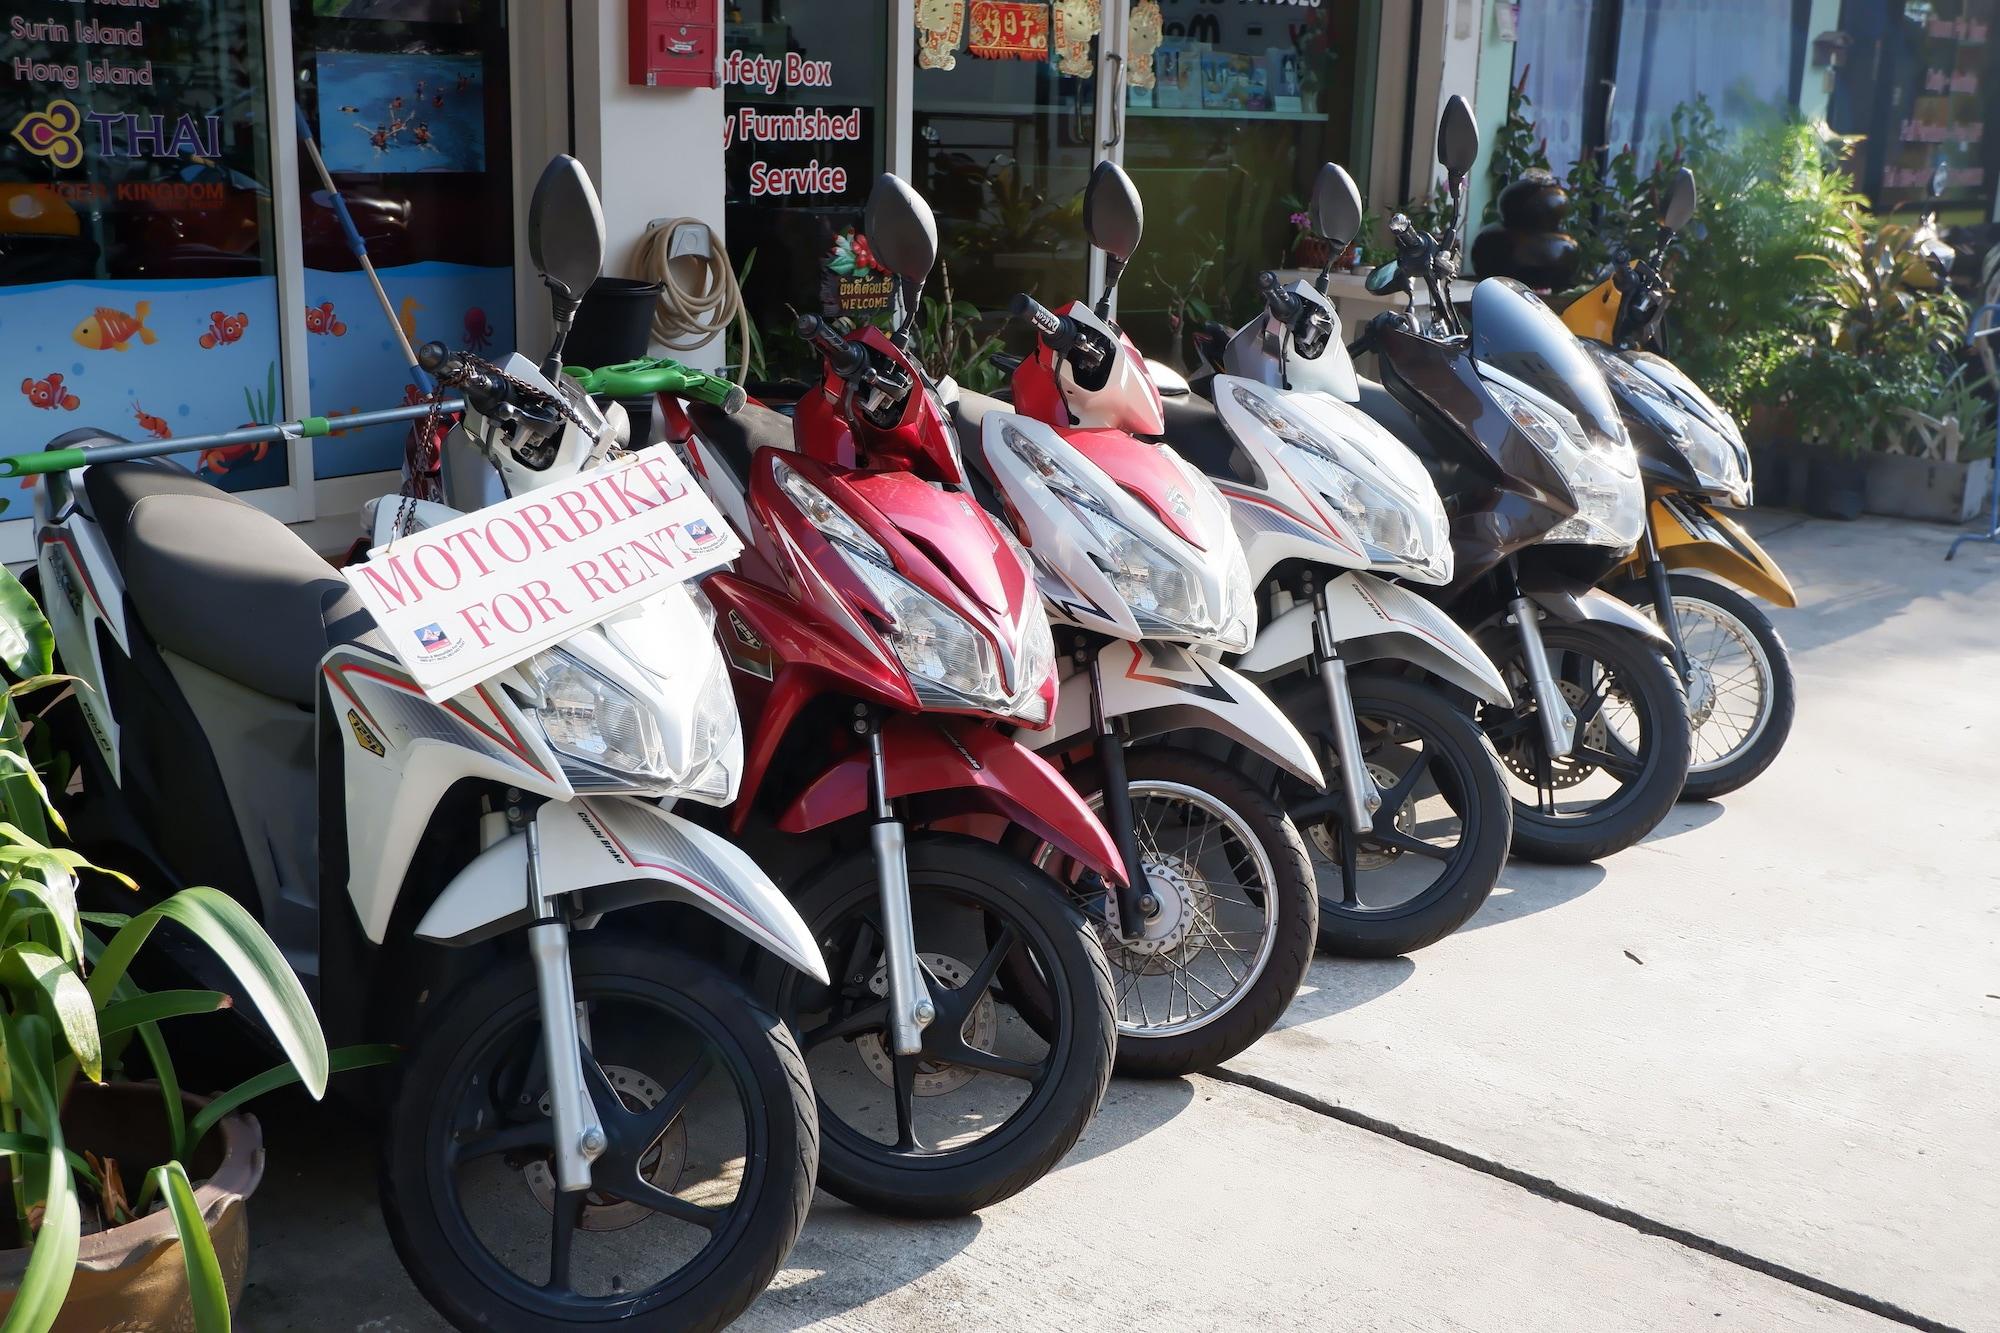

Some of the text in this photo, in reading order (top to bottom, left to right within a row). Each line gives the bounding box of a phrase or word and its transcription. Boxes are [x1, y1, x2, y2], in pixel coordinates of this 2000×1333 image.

[11, 15, 143, 46] Surin Island
[14, 57, 152, 89] Hong Island
[722, 50, 832, 94] fety Box
[85, 111, 222, 157] THAI
[739, 108, 860, 141] Furnished
[117, 182, 224, 200] KINGDOM
[750, 160, 847, 195] Service
[840, 297, 889, 310] WELCOME
[357, 456, 689, 614] MOTORBIKE
[456, 522, 697, 649] FOR RENT
[577, 811, 625, 865] Combi Brake
